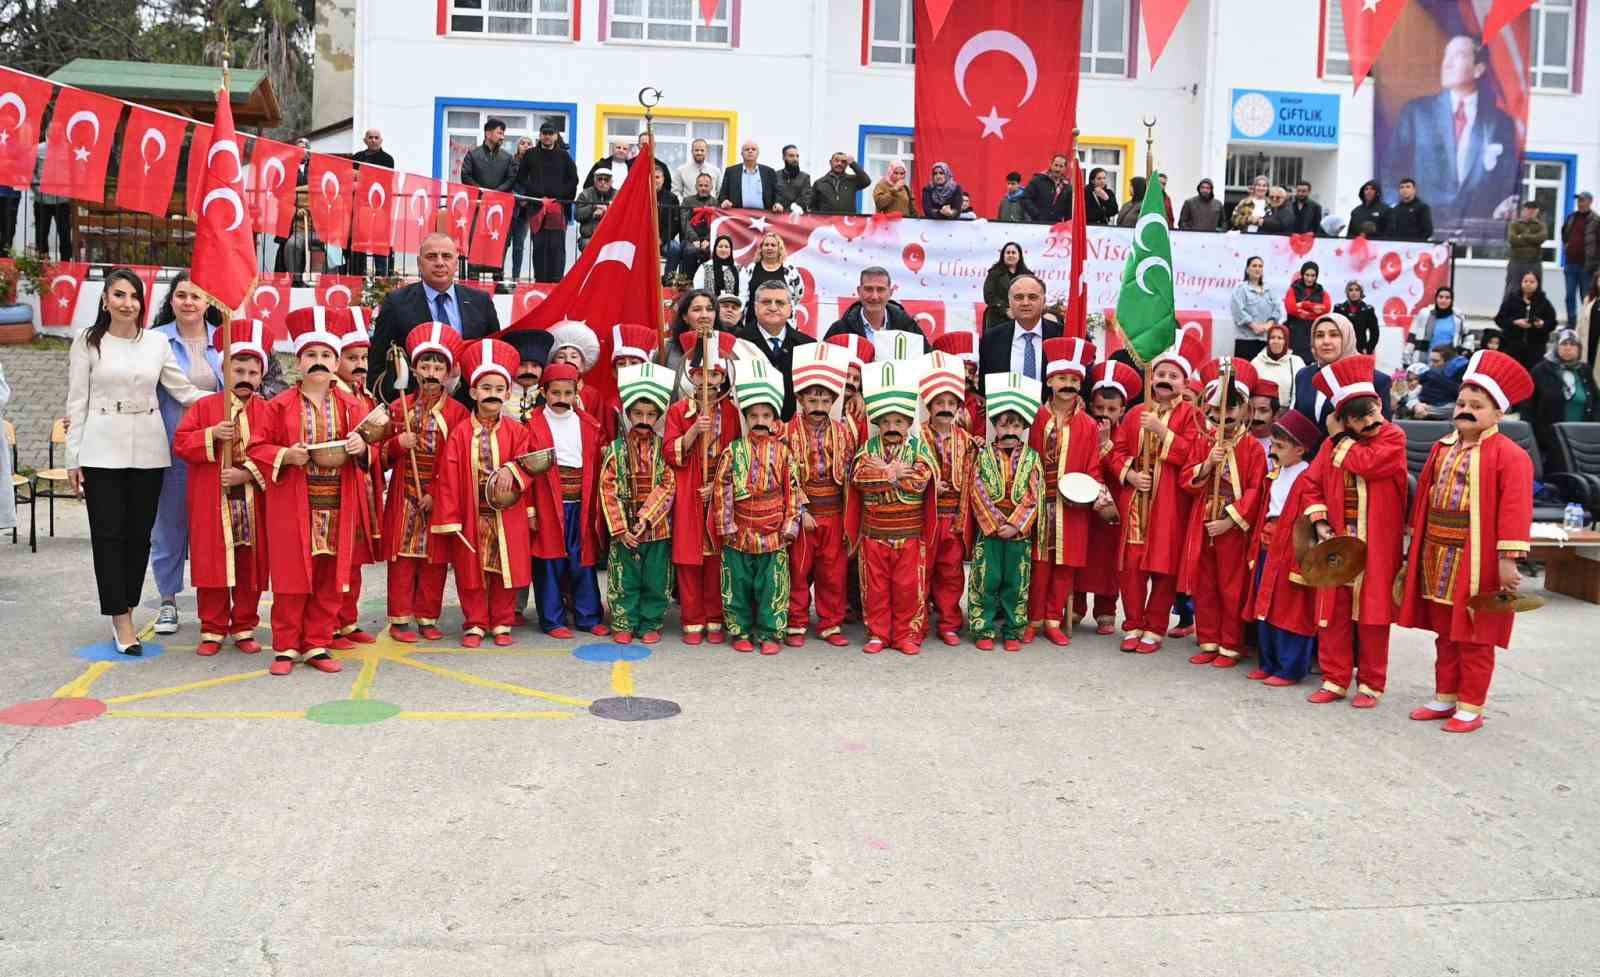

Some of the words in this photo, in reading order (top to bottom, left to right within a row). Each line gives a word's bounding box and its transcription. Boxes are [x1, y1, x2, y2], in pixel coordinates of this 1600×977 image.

[1279, 107, 1322, 122] ÇİFTLİK
[1278, 123, 1336, 138] İLKOKULU
[1042, 237, 1071, 259] 23
[1087, 237, 1132, 262] Nisa
[938, 258, 988, 278] Ulusa
[1175, 271, 1242, 294] Bayram
